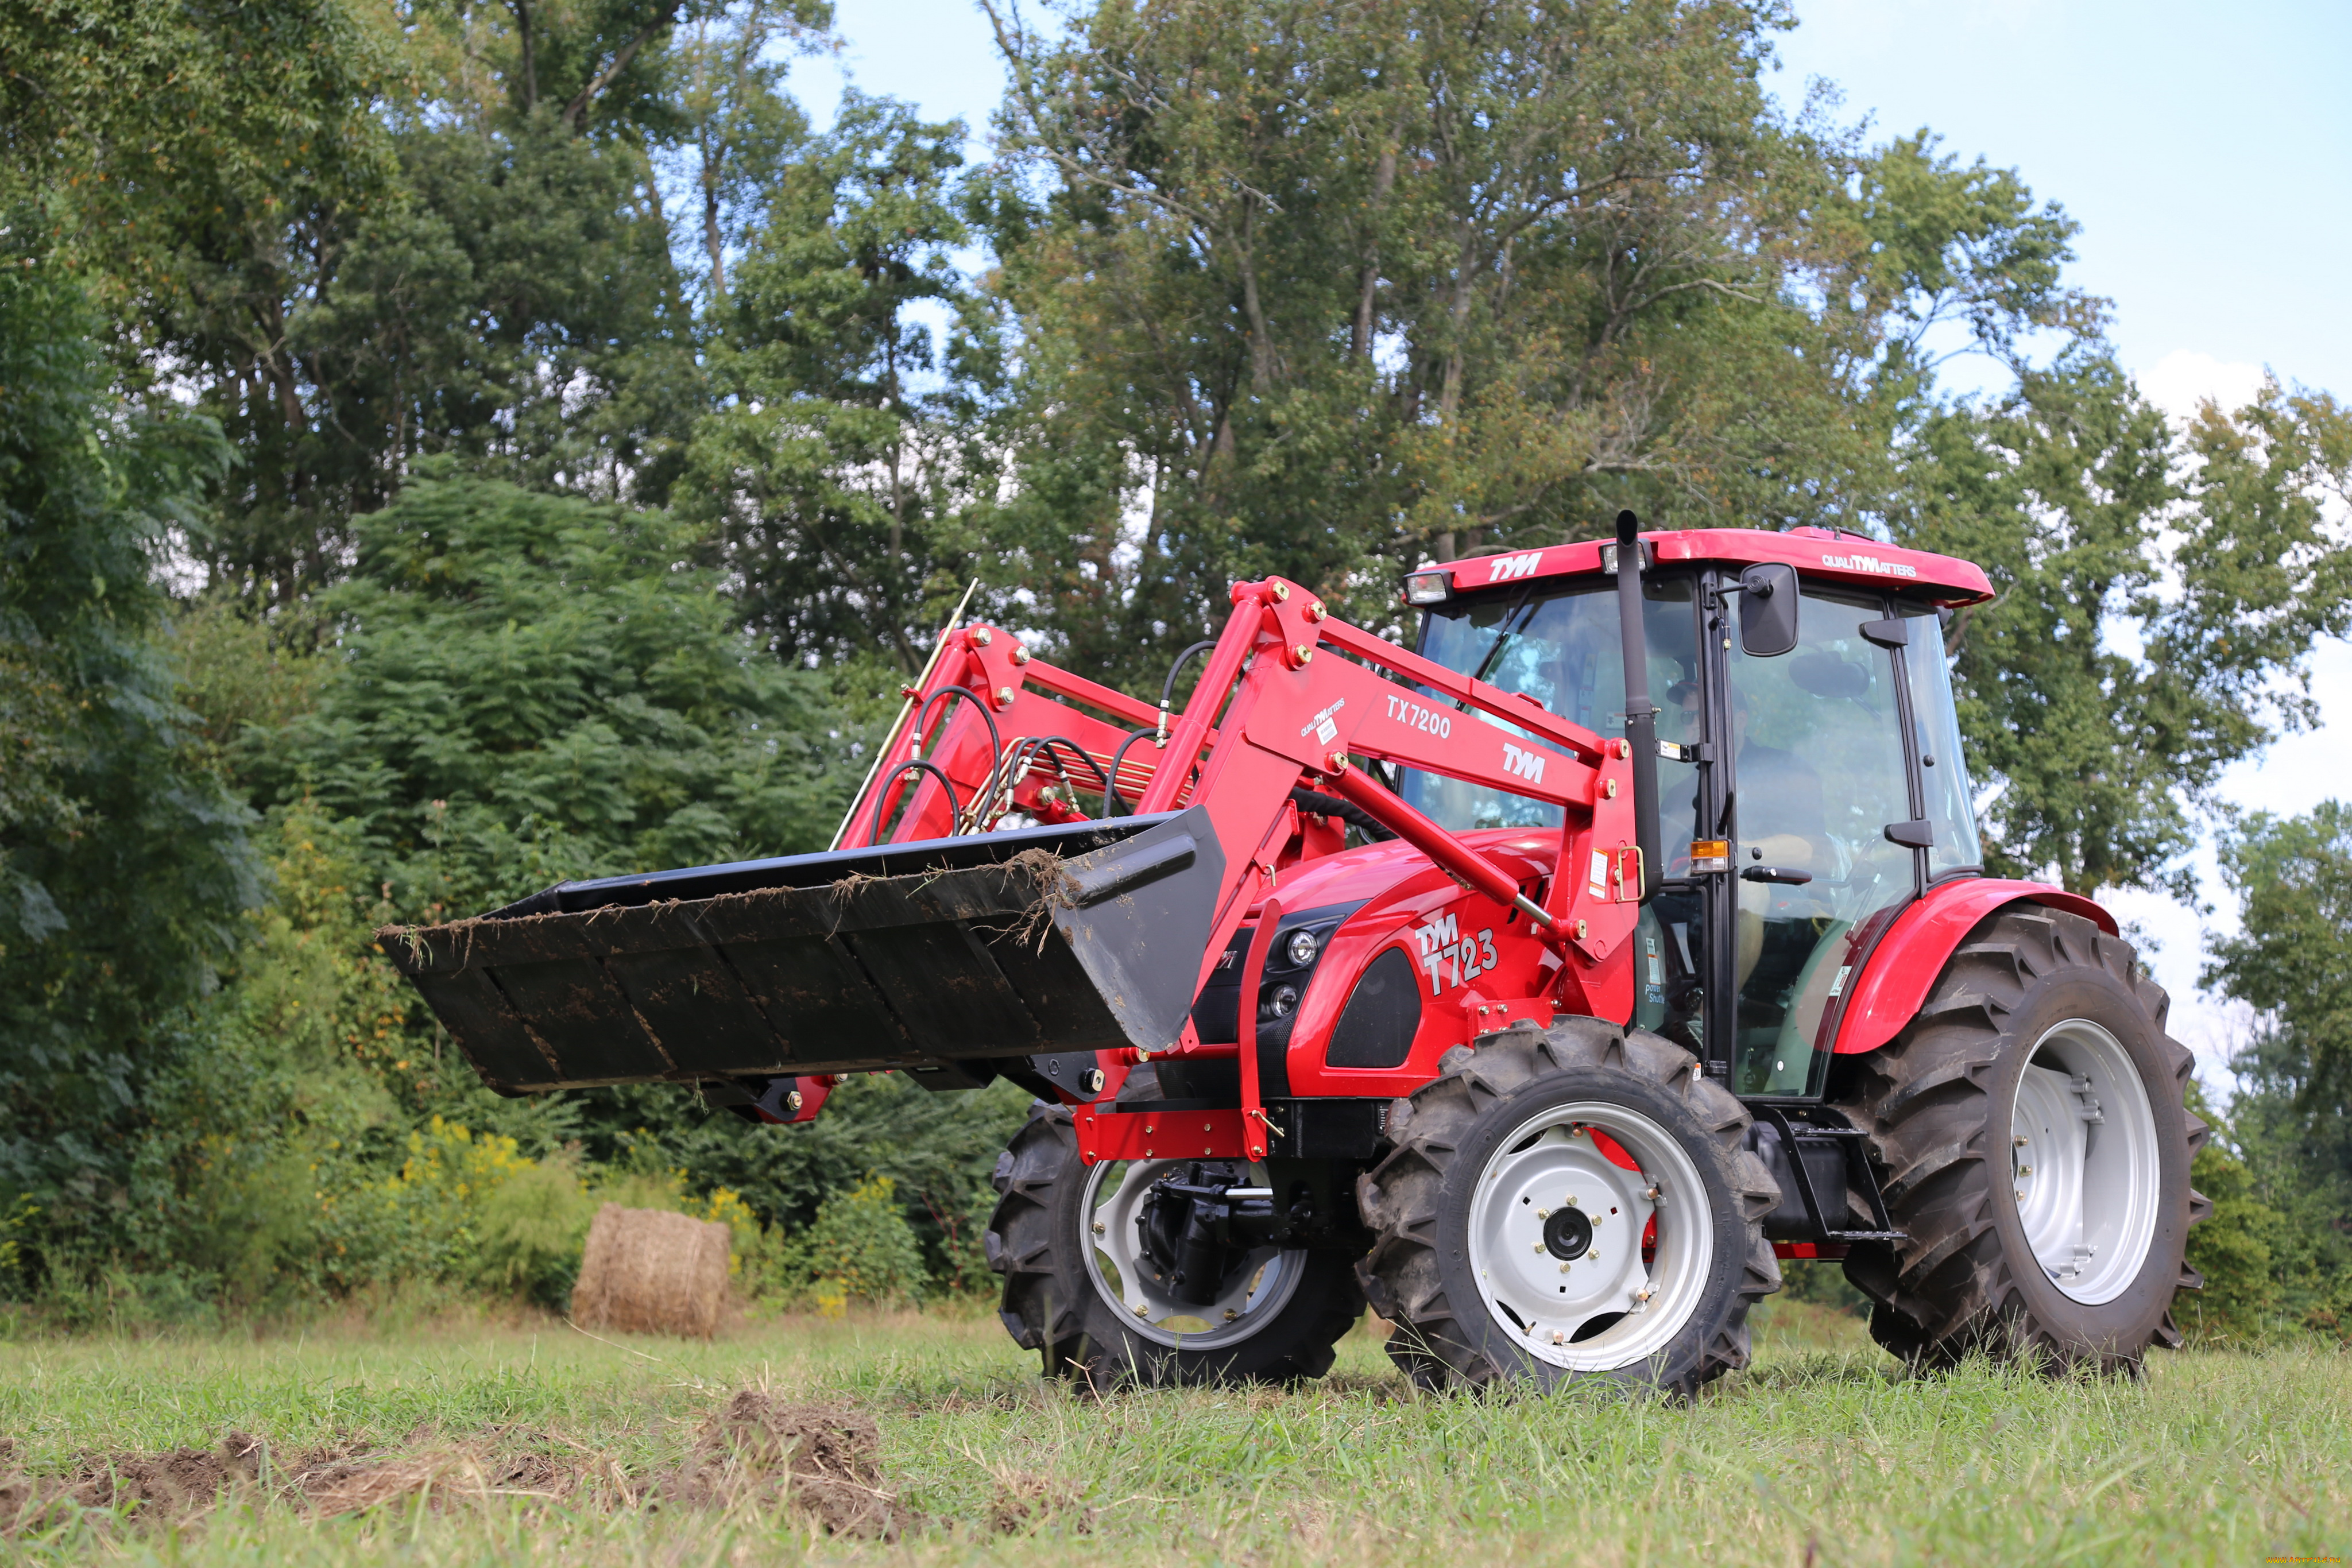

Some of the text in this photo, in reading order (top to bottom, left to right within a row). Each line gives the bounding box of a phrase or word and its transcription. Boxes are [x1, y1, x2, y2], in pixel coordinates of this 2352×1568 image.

[1489, 552, 1543, 582] TYM
[1387, 694, 1450, 739] TX7200
[1503, 742, 1545, 784] TYM
[1415, 912, 1459, 957] TYM
[1423, 927, 1498, 996] T723
